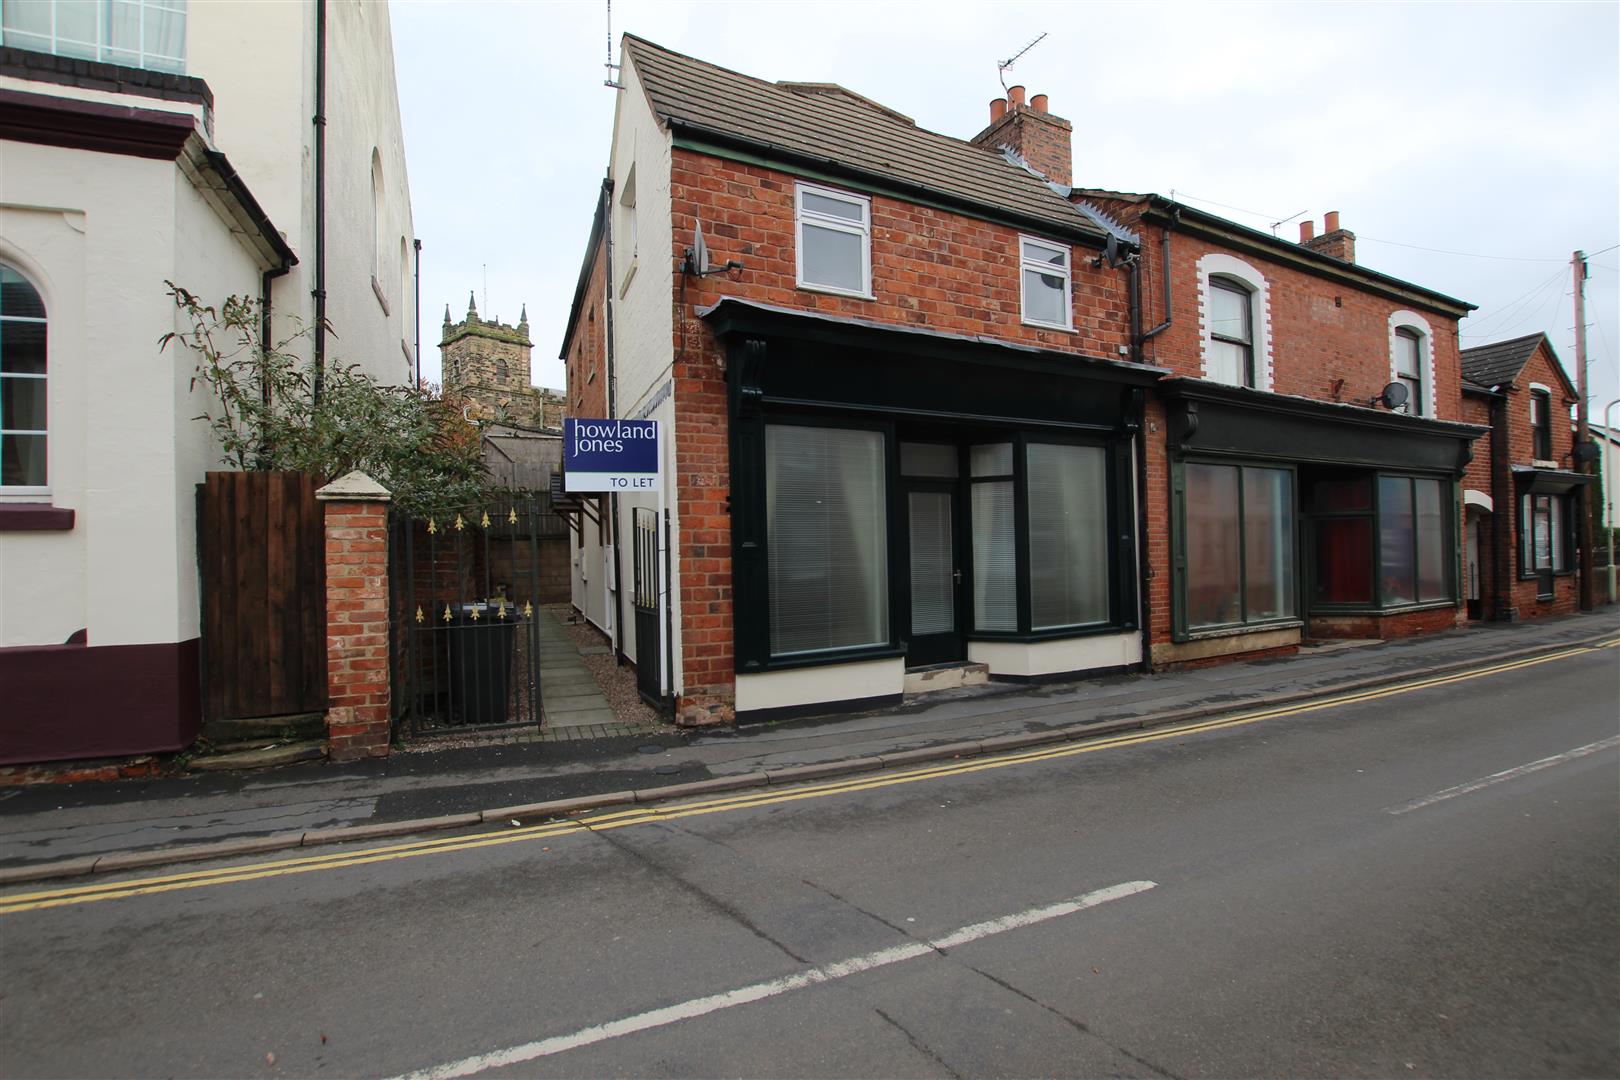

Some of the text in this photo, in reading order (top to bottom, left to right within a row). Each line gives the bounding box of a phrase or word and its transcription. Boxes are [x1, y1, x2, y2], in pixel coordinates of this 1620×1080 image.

[574, 419, 656, 439] howland
[573, 438, 624, 457] jones
[610, 477, 654, 488] TO LET
